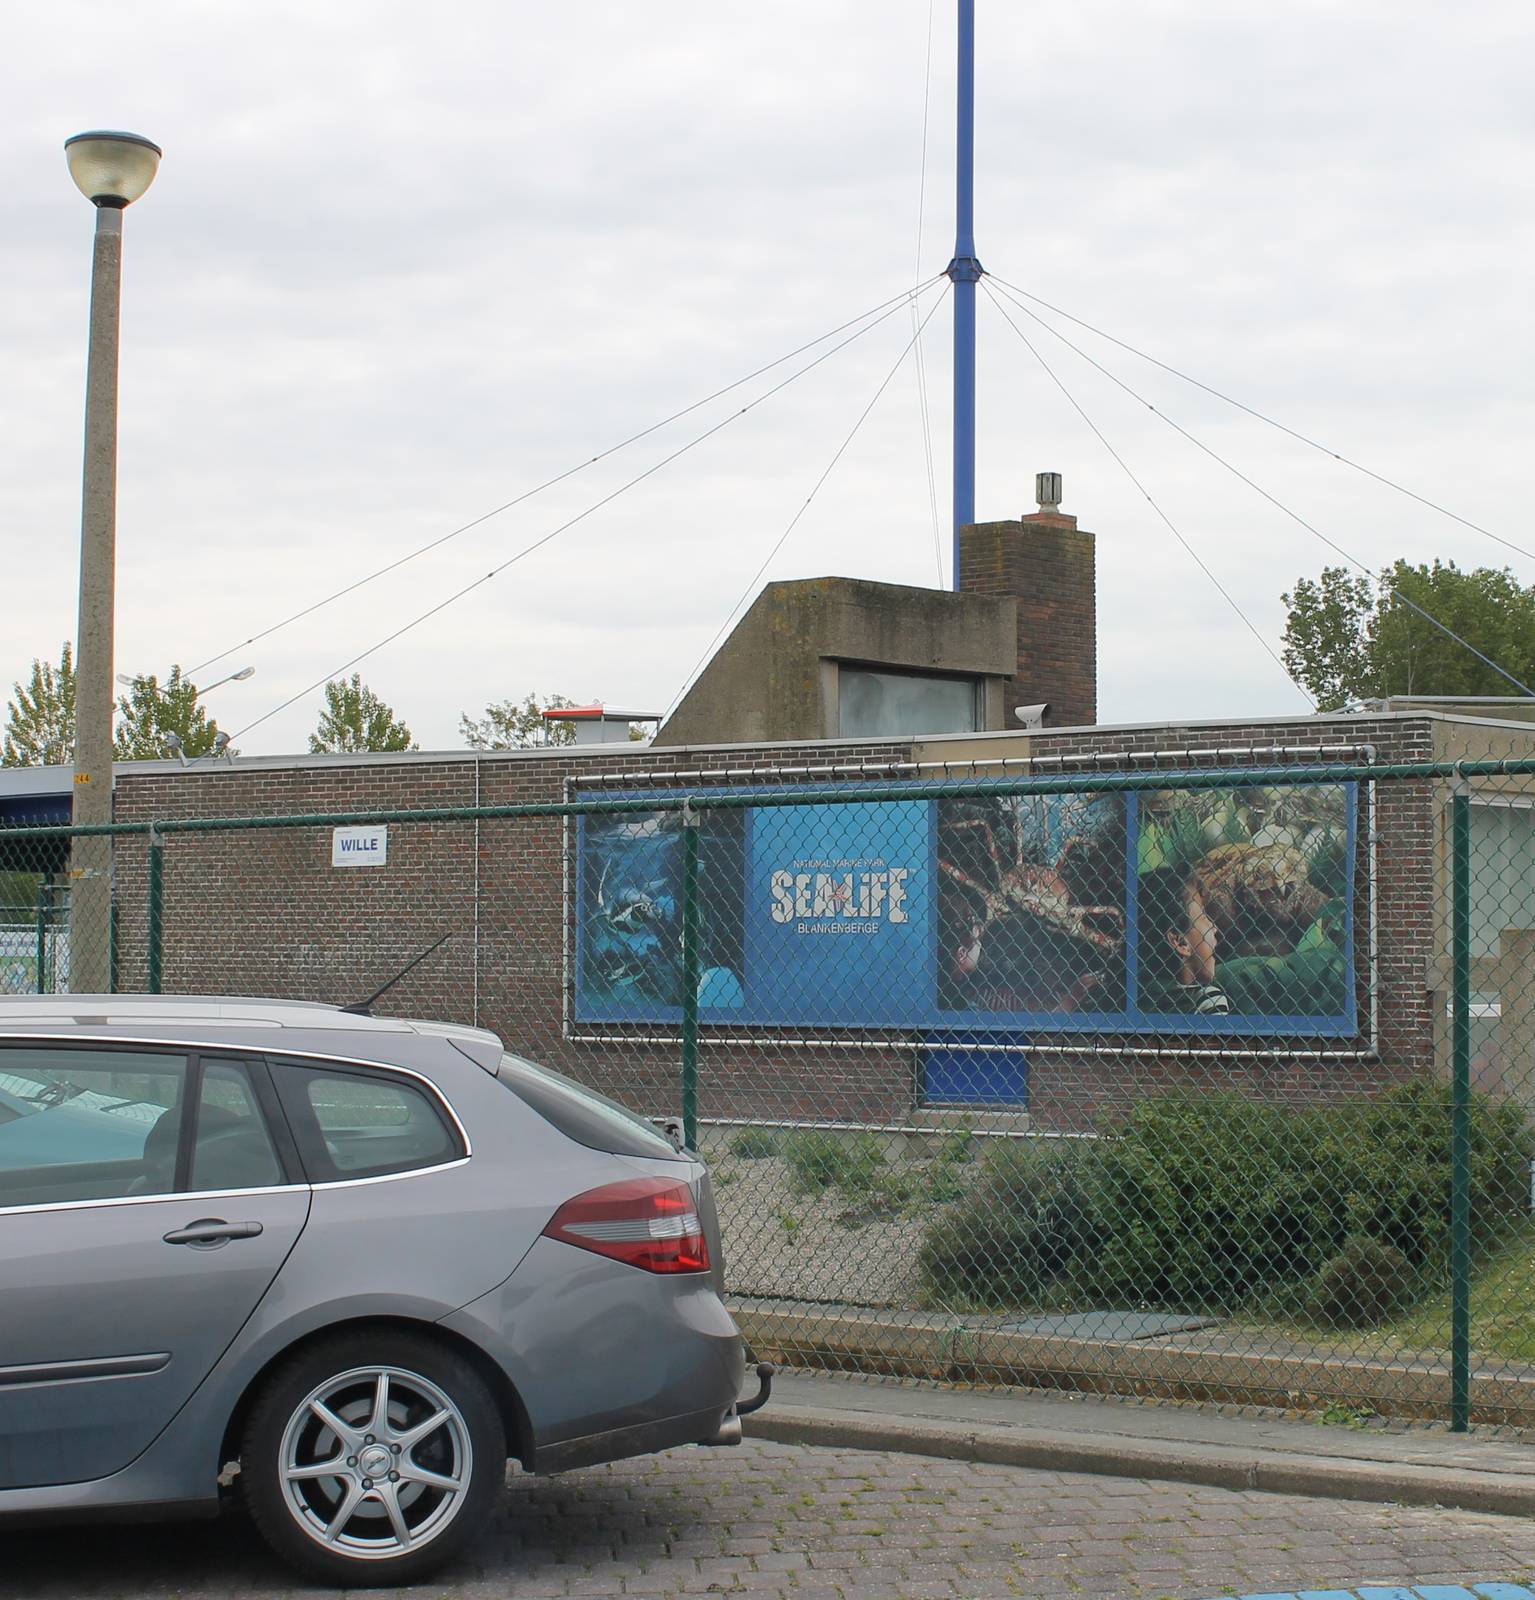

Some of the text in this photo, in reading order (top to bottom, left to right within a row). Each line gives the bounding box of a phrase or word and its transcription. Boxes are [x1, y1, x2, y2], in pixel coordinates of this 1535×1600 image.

[341, 838, 378, 851] WILLE
[793, 859, 831, 868] NATIONAL
[797, 923, 879, 934] BLANKENBERGE
